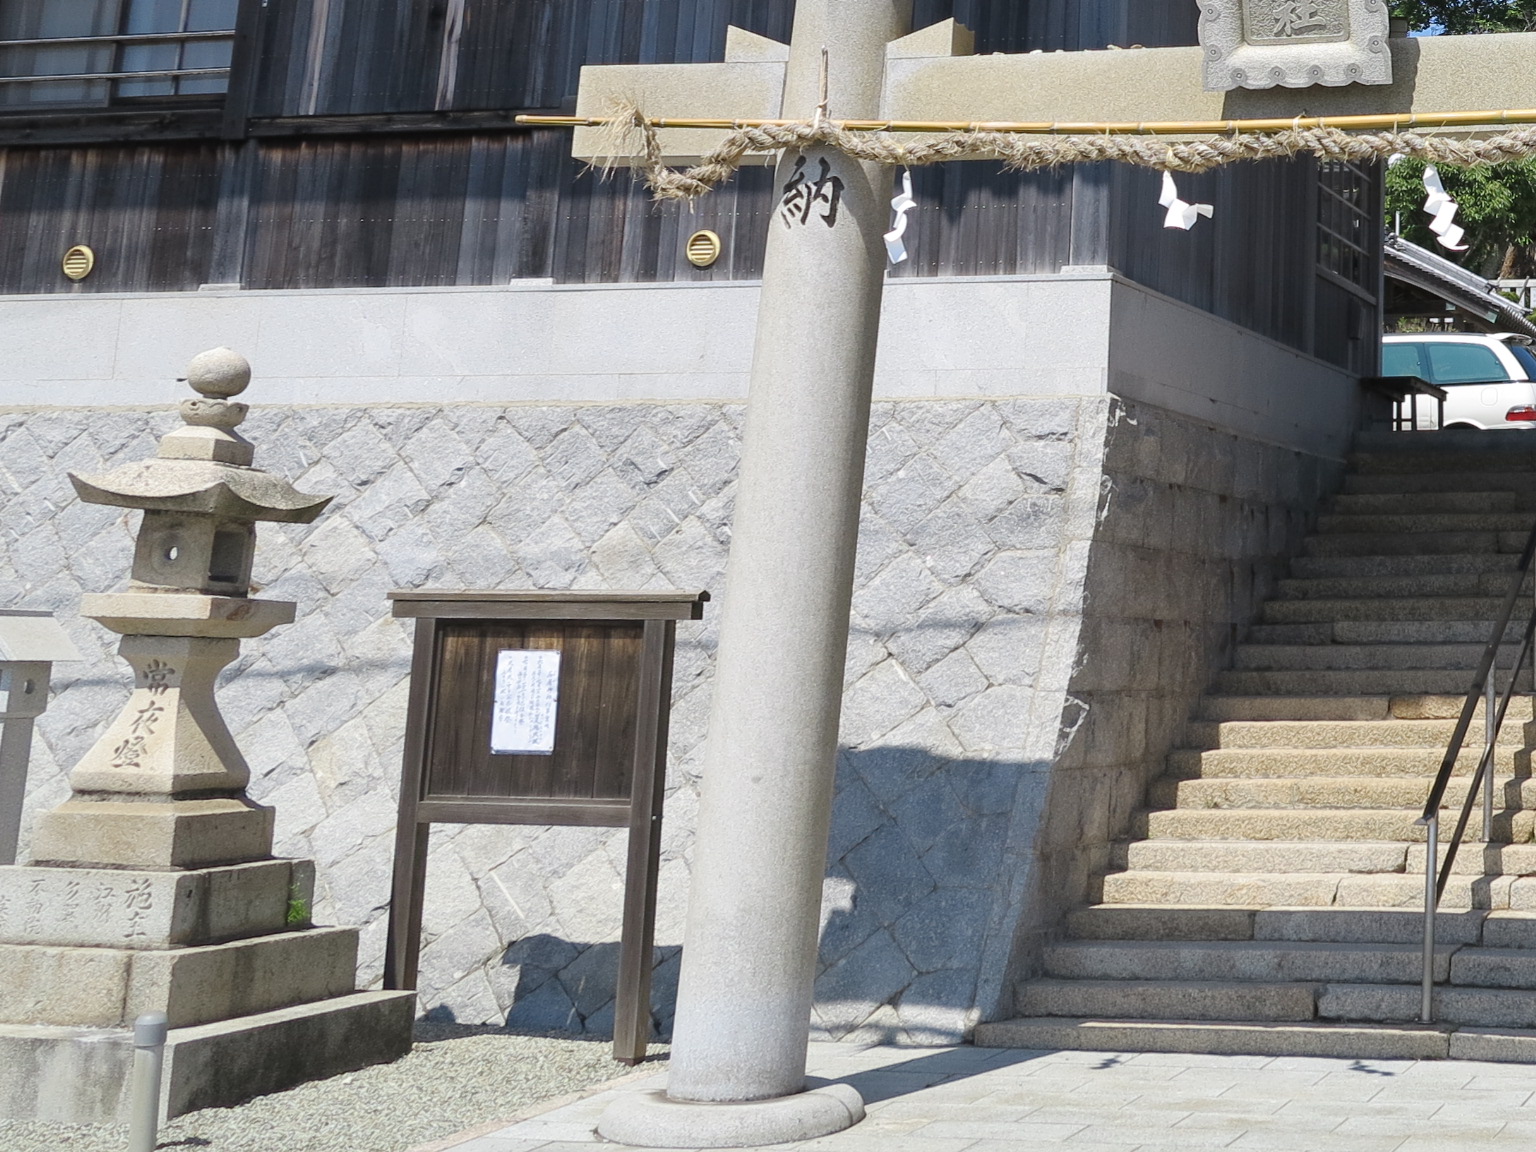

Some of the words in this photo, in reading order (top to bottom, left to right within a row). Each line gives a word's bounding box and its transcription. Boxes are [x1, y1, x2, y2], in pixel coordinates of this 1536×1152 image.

[780, 155, 845, 229] 納
[109, 659, 176, 768] 常夜燈
